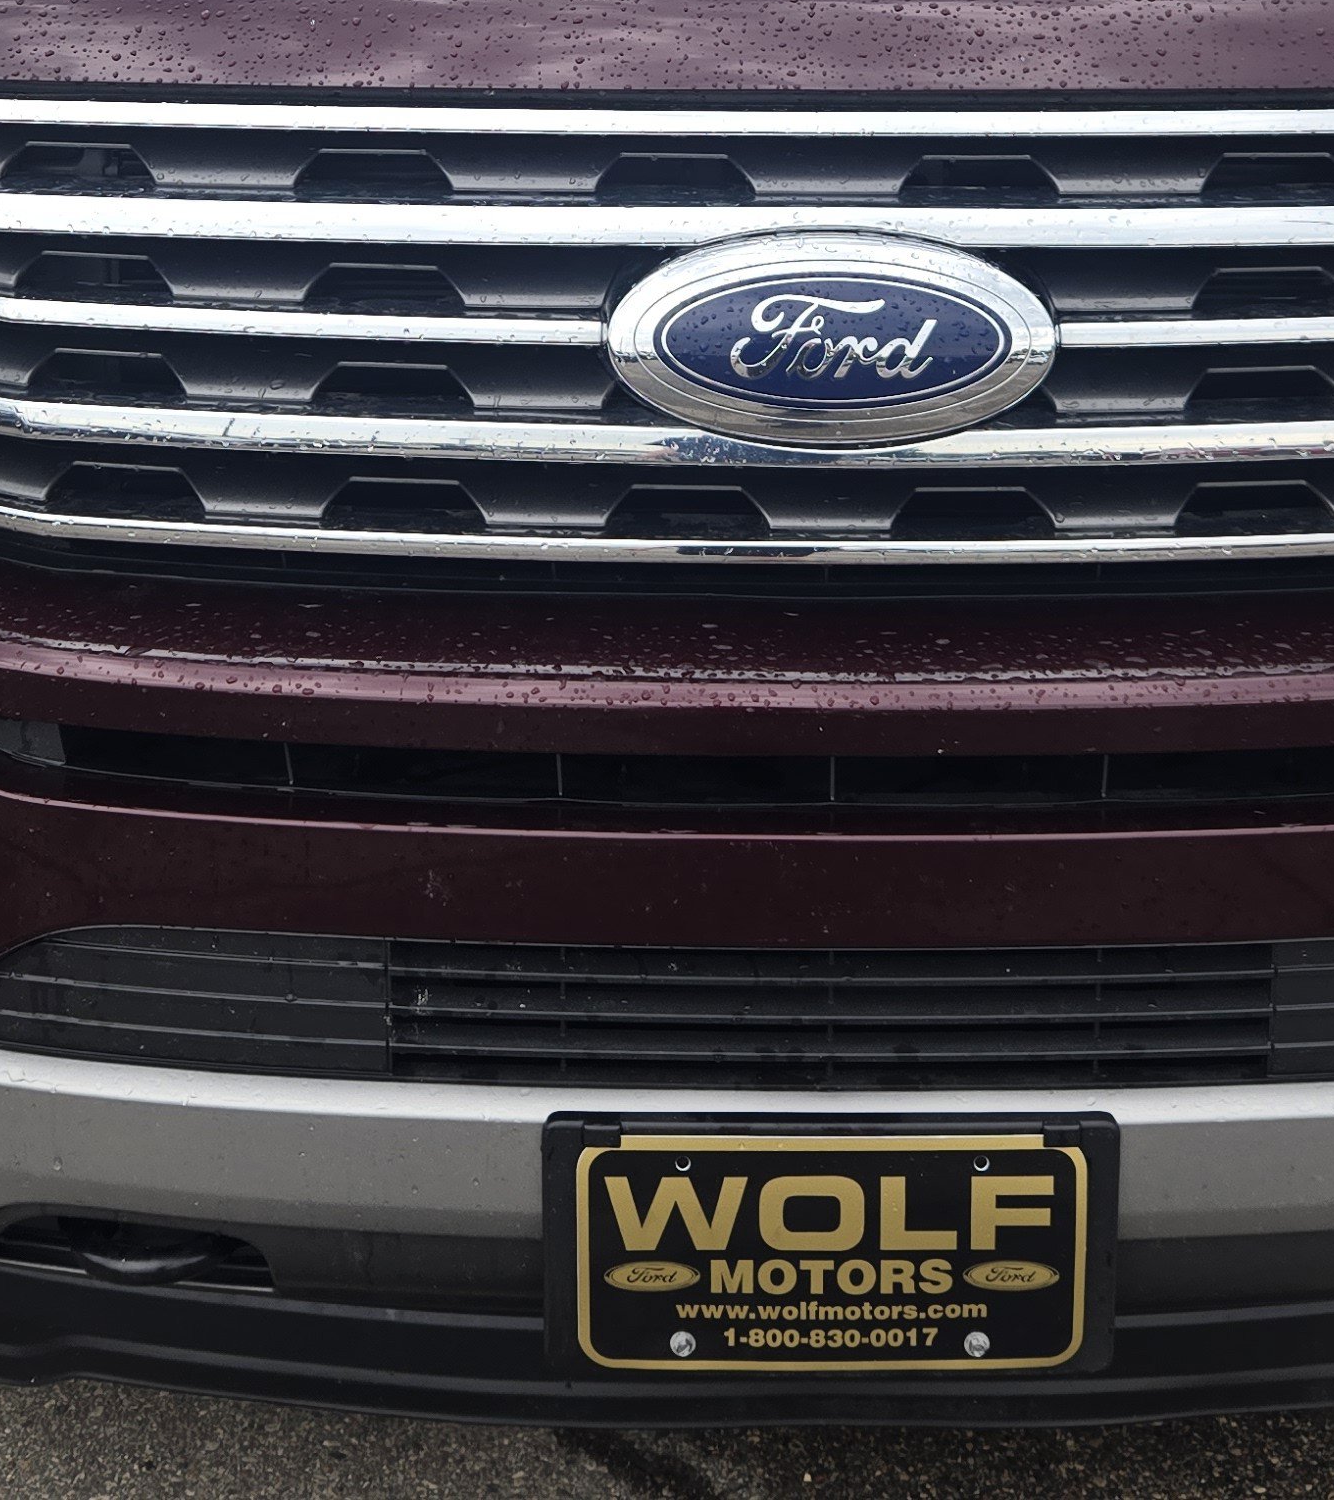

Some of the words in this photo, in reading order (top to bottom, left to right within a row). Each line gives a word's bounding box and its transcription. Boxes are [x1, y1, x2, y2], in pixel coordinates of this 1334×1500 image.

[730, 293, 938, 380] Ford
[603, 1175, 1055, 1251] WOLF
[626, 1266, 678, 1284] Ford
[710, 1258, 953, 1295] MOTORS
[985, 1266, 1037, 1284] Ford
[675, 1300, 988, 1321] www.wolfmotors.com
[723, 1327, 939, 1348] 1-800-830-0017
